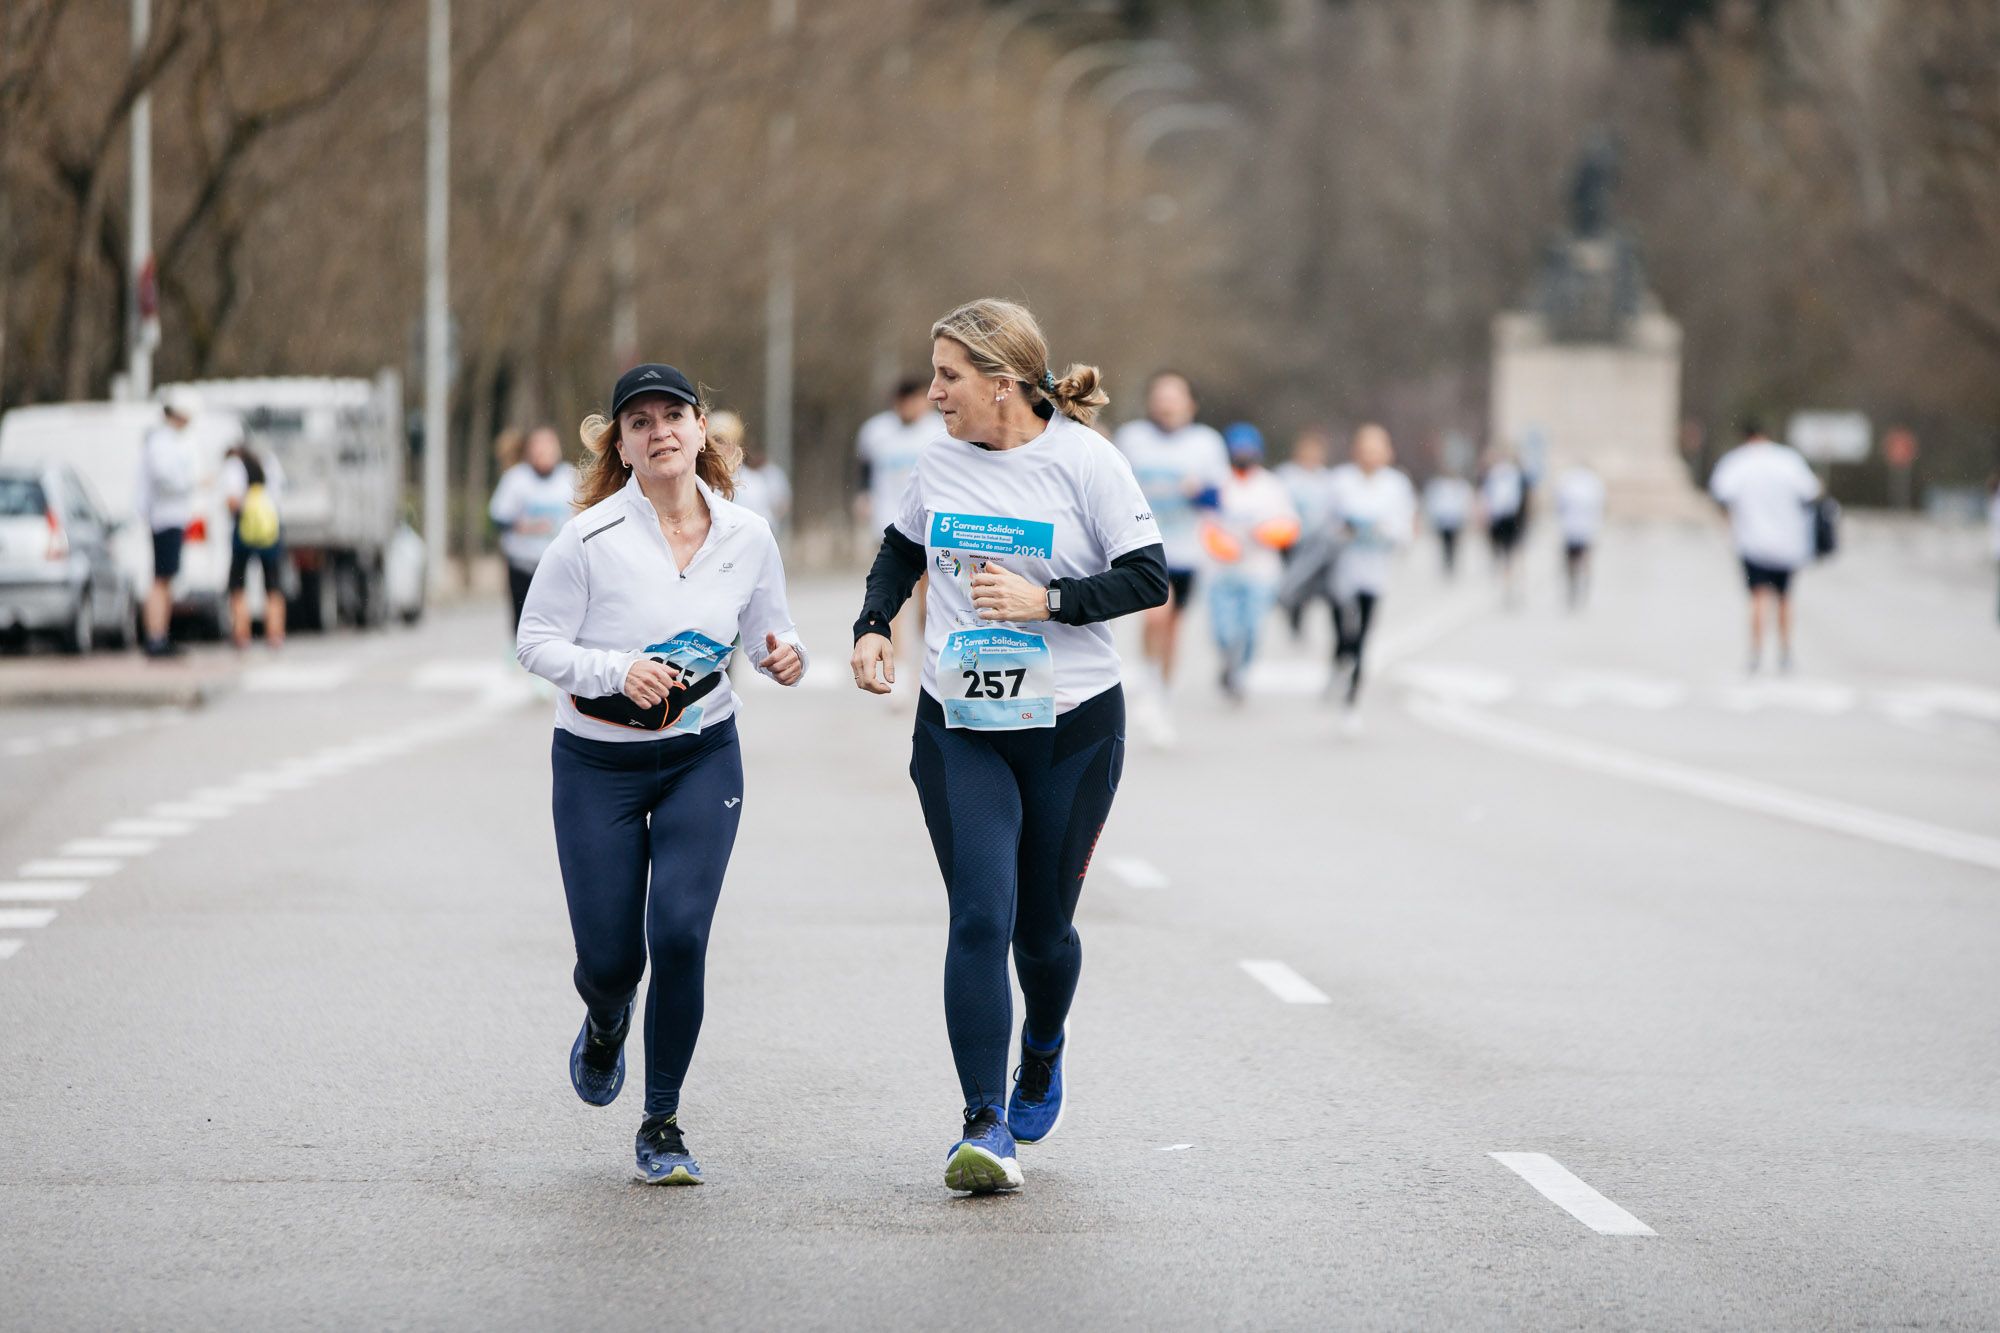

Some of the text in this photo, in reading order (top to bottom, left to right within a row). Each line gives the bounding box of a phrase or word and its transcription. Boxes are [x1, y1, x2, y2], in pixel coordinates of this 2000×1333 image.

[953, 521, 985, 532] Carrera
[987, 524, 1025, 536] Solidaria
[959, 540, 980, 548] Sábado
[1013, 544, 1046, 558] 2026
[964, 638, 990, 647] Carrera
[992, 636, 1028, 647] Solidaria
[962, 668, 1027, 699] 257
[1021, 712, 1033, 720] CSL
